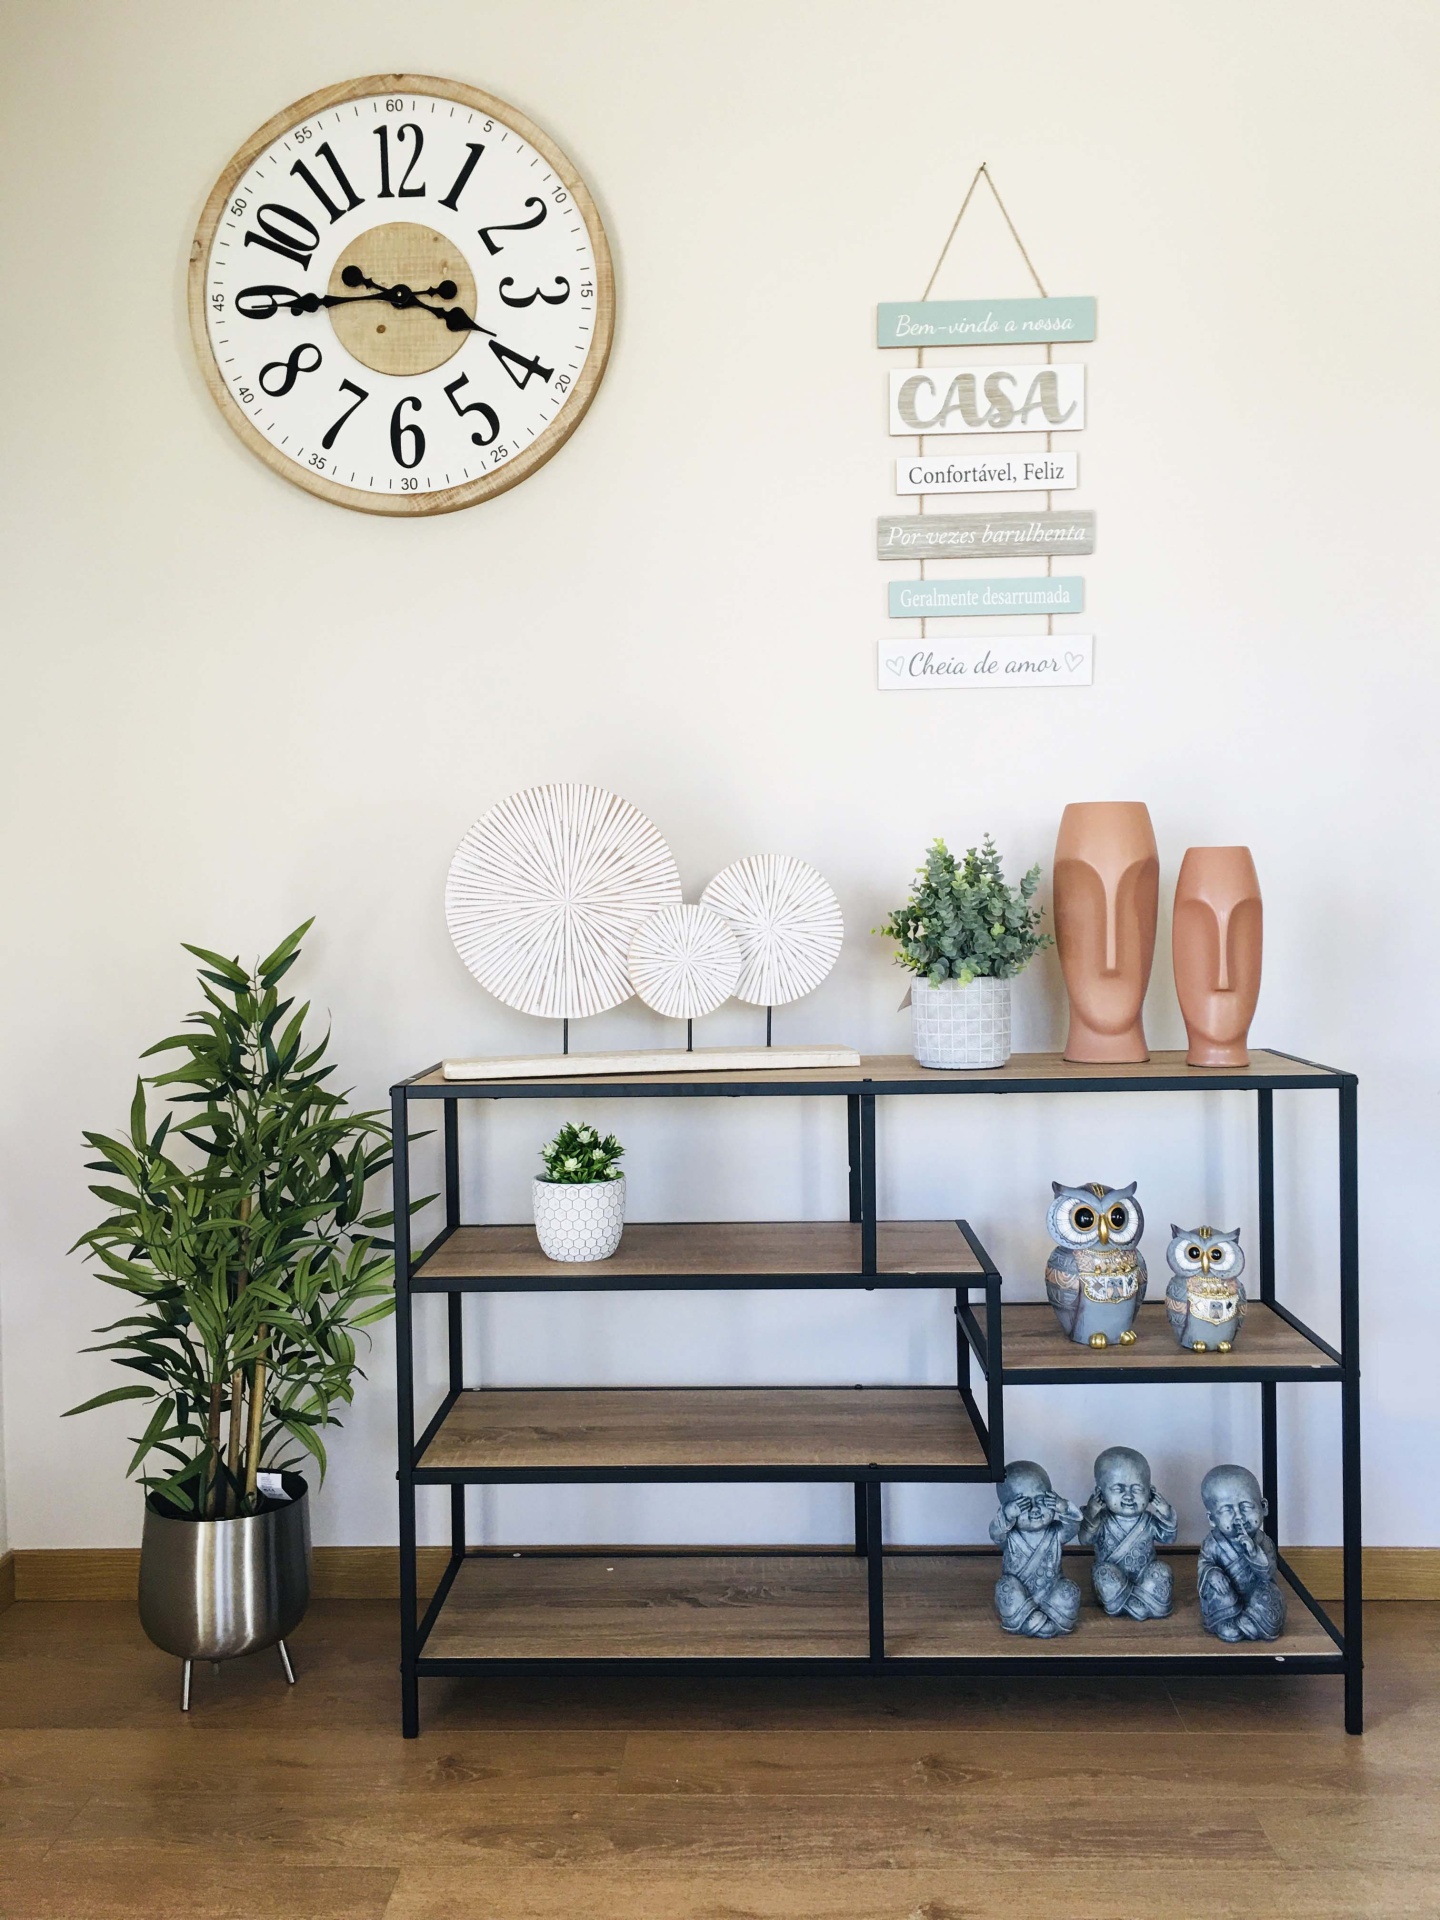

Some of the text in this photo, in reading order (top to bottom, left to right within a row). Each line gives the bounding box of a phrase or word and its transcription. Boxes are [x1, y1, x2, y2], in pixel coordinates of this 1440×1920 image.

[386, 98, 404, 113] 60
[295, 127, 313, 144] 55
[484, 119, 494, 133] 5
[373, 123, 426, 198] 12
[290, 141, 366, 224] 11
[438, 142, 485, 211] 1
[552, 185, 567, 203] 10
[231, 198, 248, 217] 50
[244, 203, 320, 271] 10
[477, 197, 547, 255] 2
[499, 276, 570, 308] 3
[580, 281, 593, 298] 15
[212, 294, 225, 312] 45
[235, 285, 302, 320] 9
[896, 312, 1075, 337] Bem-vindo a nossa
[259, 343, 322, 397] 8
[489, 340, 554, 390] 4
[239, 385, 255, 404] 40
[555, 374, 571, 393] 20
[444, 372, 500, 446] 5
[898, 370, 1077, 429] CASA
[322, 379, 369, 449] 7
[390, 396, 426, 468] 6
[308, 453, 327, 470] 35
[490, 445, 509, 463] 25
[401, 477, 418, 491] 30
[909, 462, 1064, 484] Confortável, Feliz
[886, 523, 1086, 546] Por vezes barulhenta
[900, 585, 1071, 607] Geralmente desarrumada
[909, 650, 1061, 676] Cheia de amor
